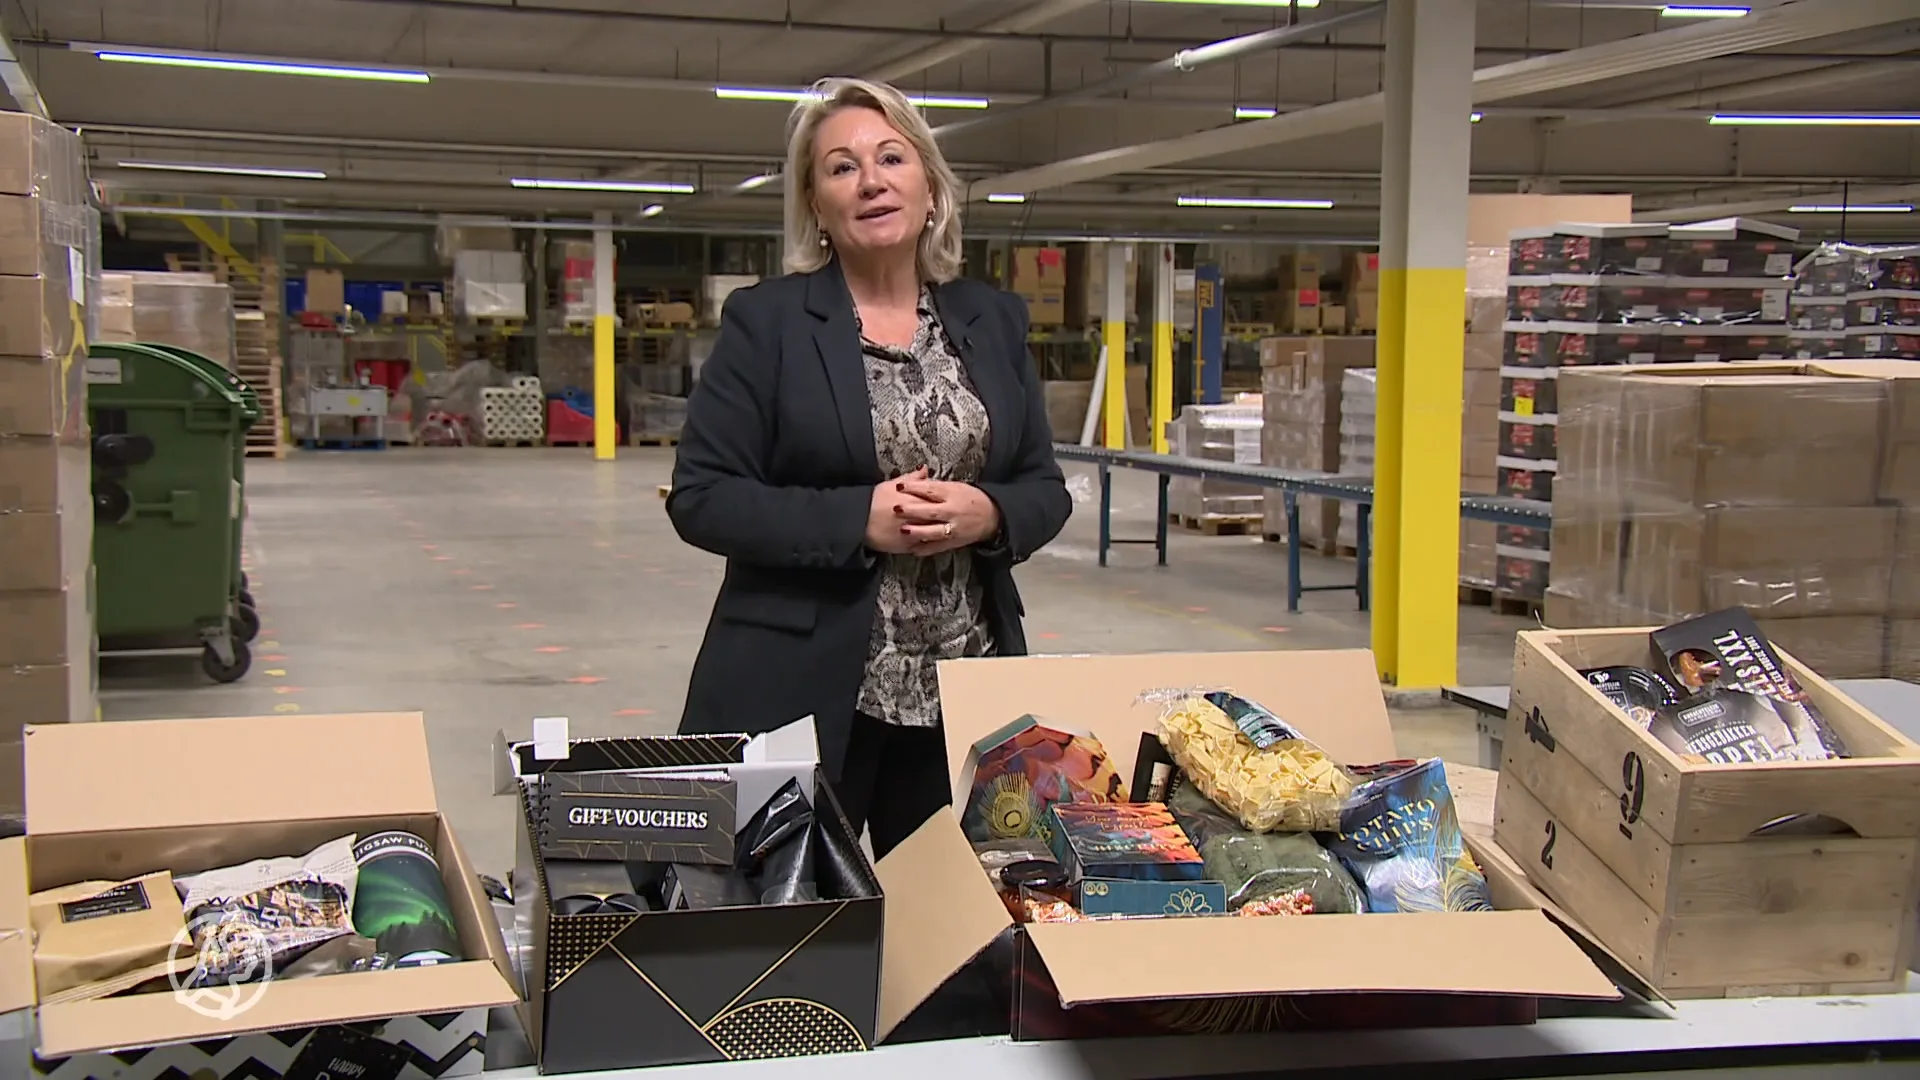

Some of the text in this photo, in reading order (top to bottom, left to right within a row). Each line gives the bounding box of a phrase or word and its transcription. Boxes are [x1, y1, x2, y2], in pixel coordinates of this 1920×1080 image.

[1713, 629, 1754, 667] XXL
[569, 807, 707, 829] GIFT VOUCHERS
[355, 837, 402, 859] JIGSAW
[1541, 820, 1556, 870] 2
